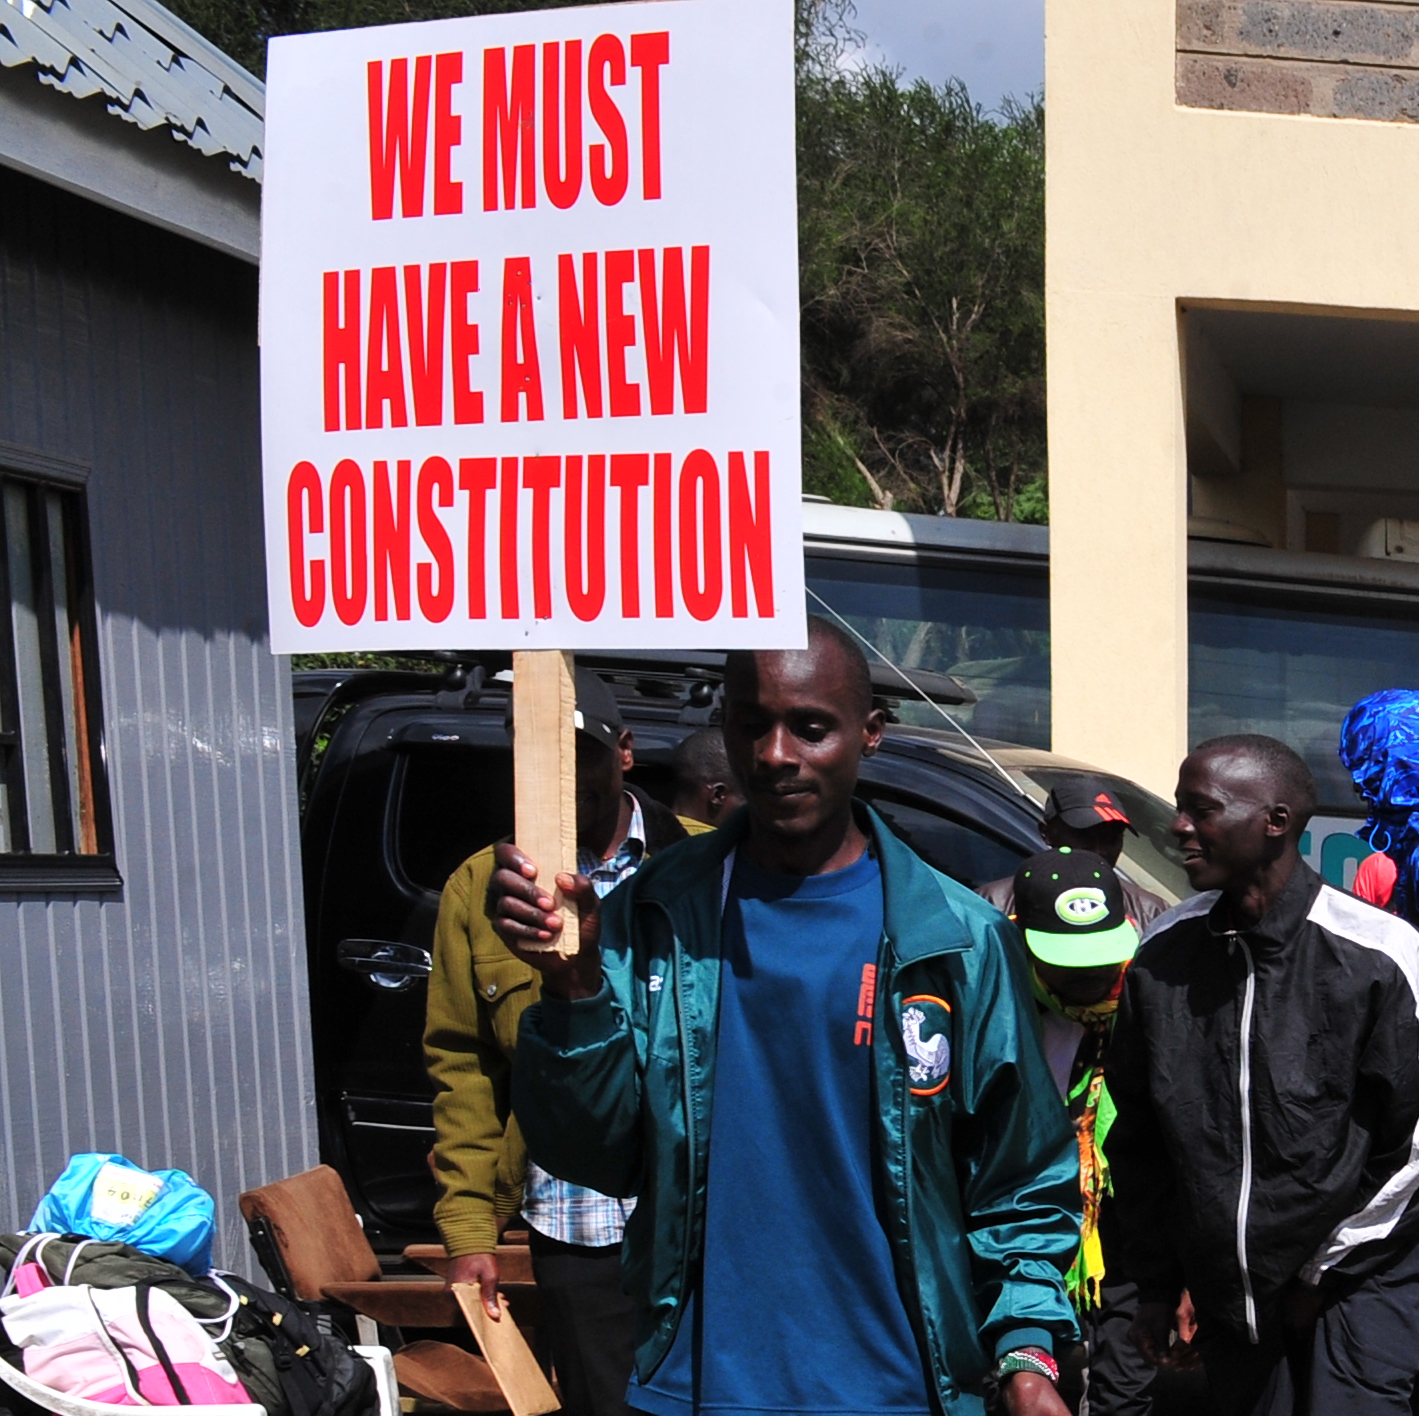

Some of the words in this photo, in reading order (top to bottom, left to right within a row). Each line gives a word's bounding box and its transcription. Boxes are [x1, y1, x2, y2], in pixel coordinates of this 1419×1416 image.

[367, 51, 464, 221] WE
[482, 31, 670, 212] MUST
[323, 259, 485, 432] HAVE
[500, 256, 545, 423] A
[557, 245, 710, 420] NEW
[287, 448, 775, 628] CONSTITUTION
